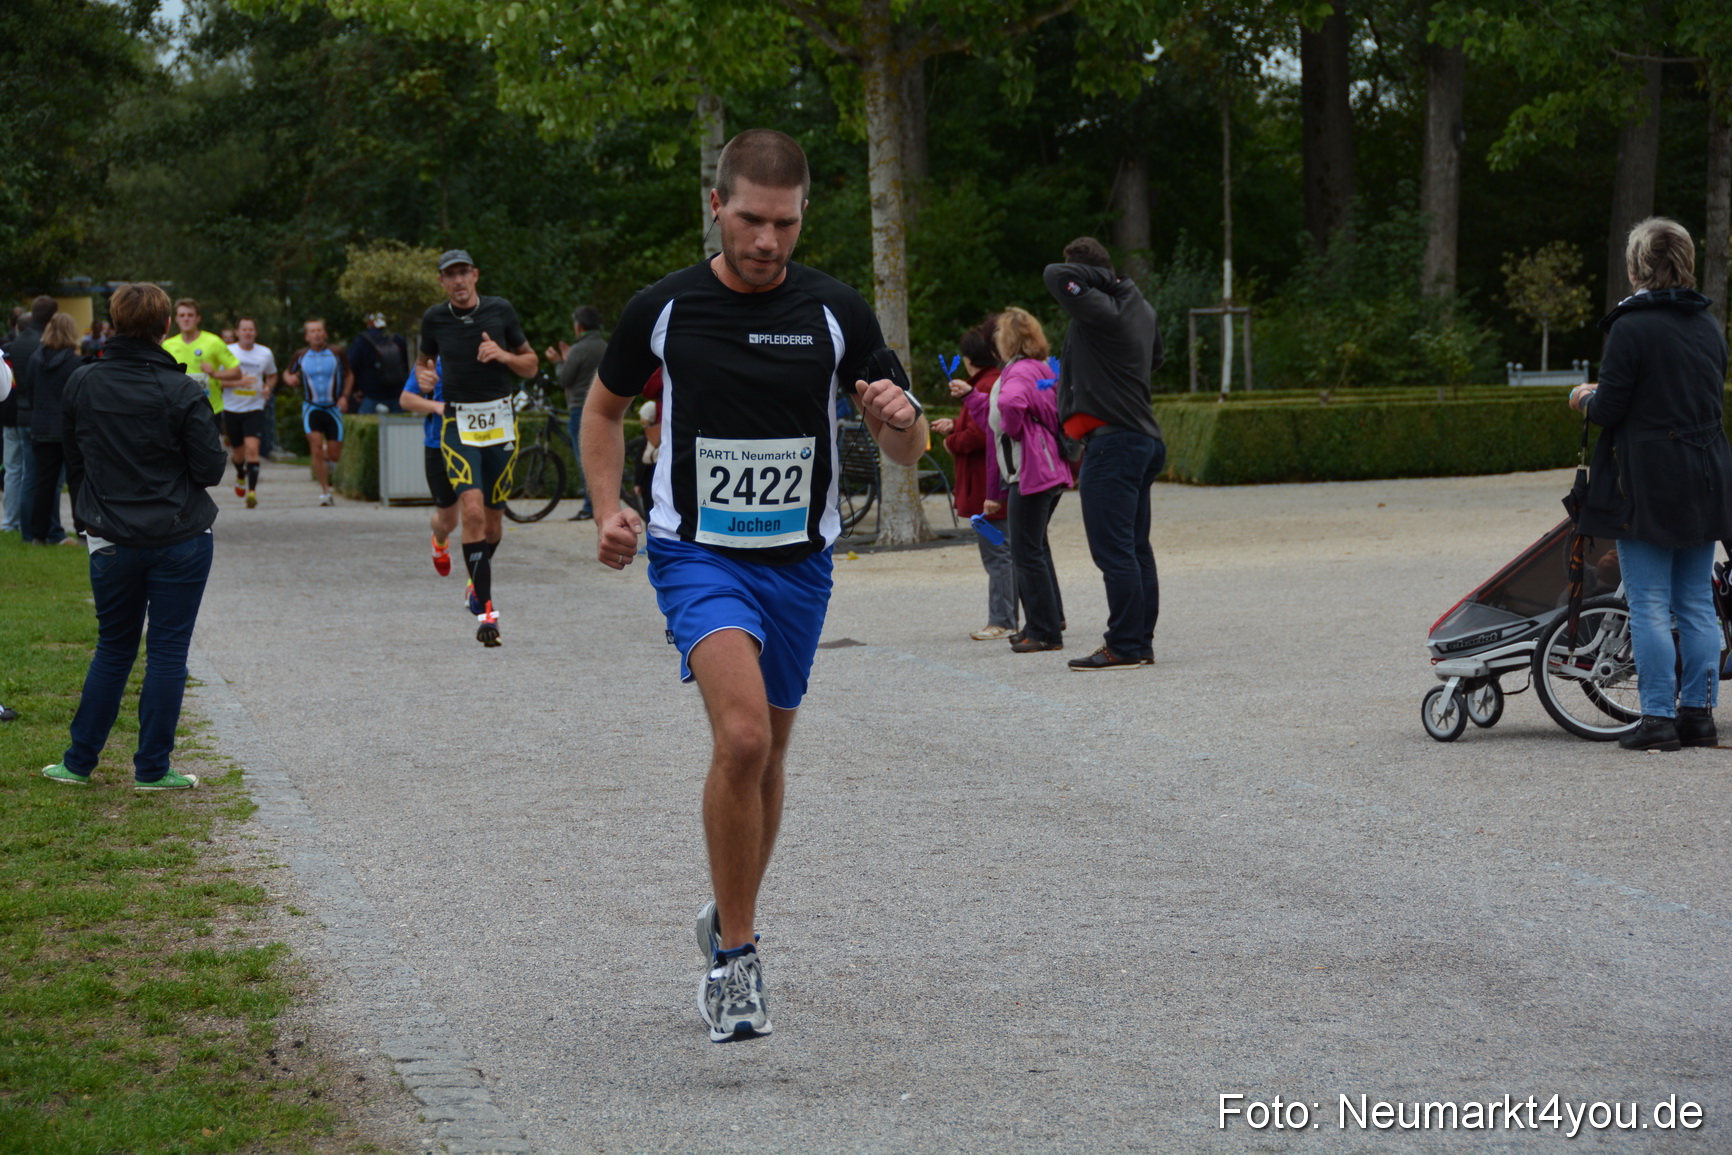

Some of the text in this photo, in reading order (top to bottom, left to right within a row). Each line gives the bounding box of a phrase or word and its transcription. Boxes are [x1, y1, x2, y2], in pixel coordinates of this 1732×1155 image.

[759, 334, 813, 345] PFLEIDERER
[467, 412, 495, 430] 264
[699, 448, 797, 461] PARTL Neumarkt
[709, 465, 803, 506] 2422
[727, 516, 781, 533] Jochen
